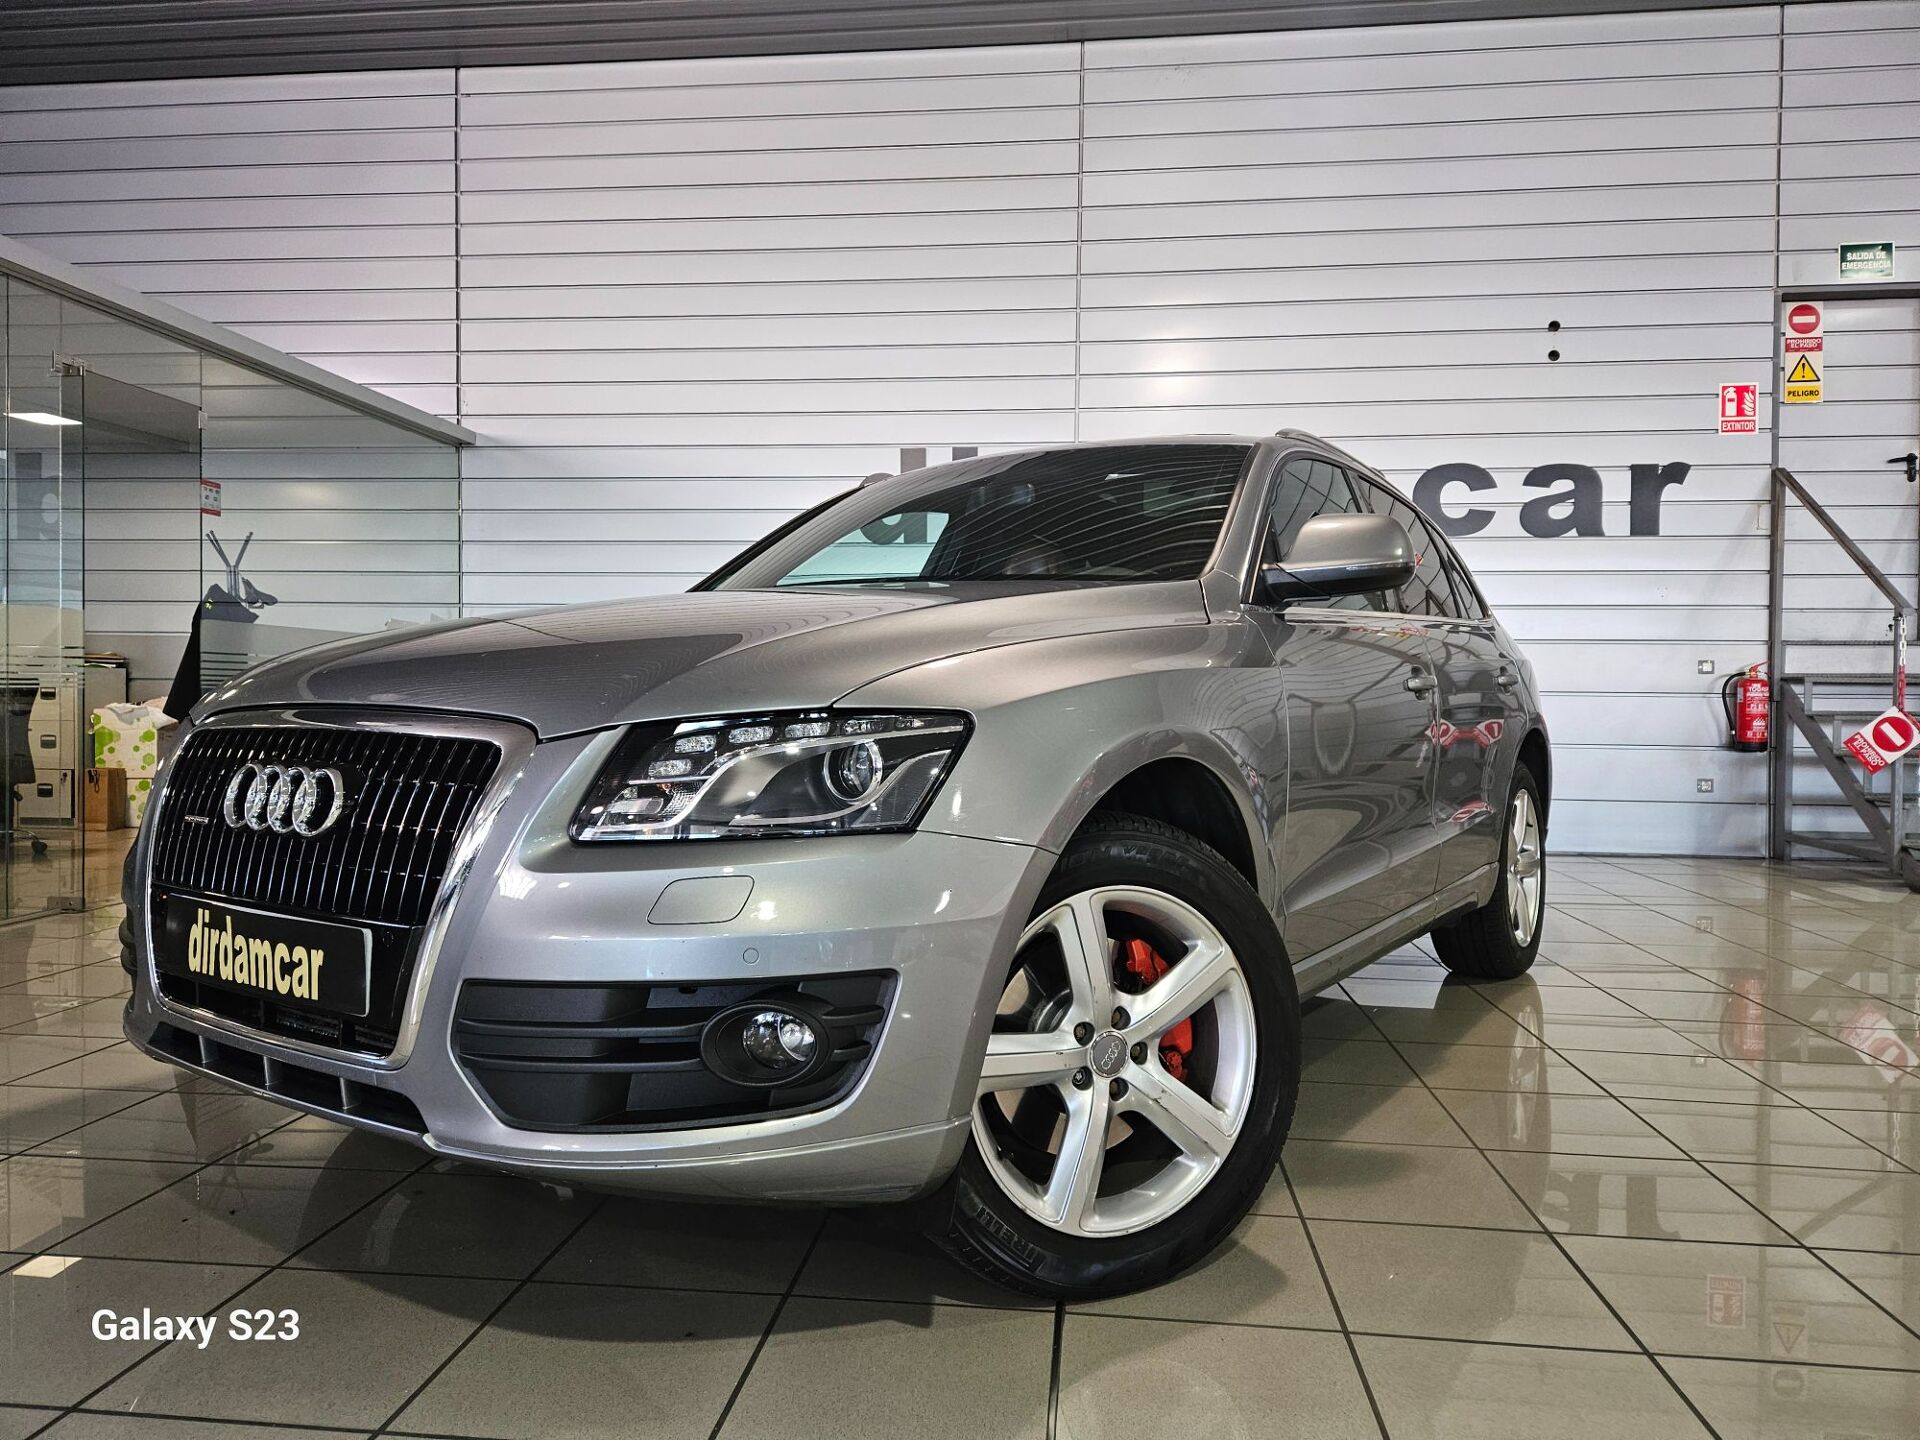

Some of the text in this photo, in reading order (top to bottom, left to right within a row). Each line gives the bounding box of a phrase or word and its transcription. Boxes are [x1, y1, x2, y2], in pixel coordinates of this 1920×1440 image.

[1846, 250, 1887, 261] SALIDA DE
[1841, 260, 1892, 270] EMERGENCIA
[1721, 420, 1755, 431] EXTINTOR
[188, 908, 324, 1000] dirdamcar
